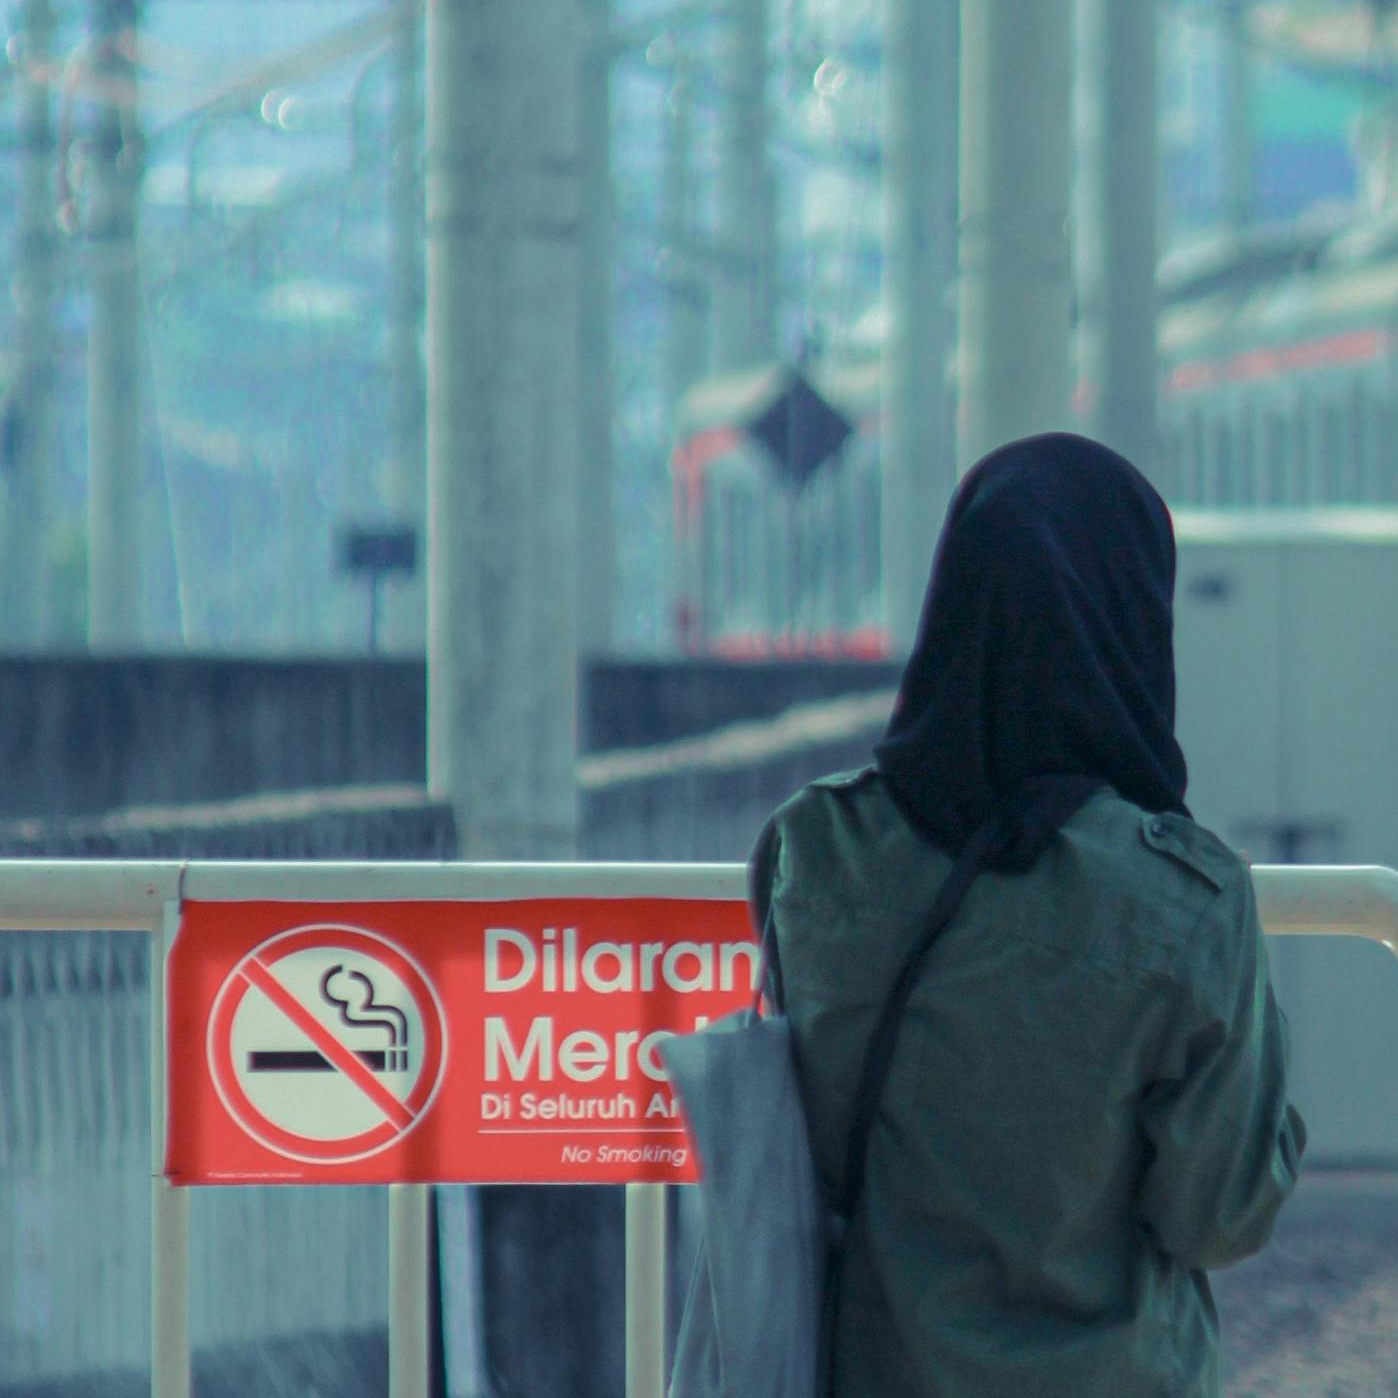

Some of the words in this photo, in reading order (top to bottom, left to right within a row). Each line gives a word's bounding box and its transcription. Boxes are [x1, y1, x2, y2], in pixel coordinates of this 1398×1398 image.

[484, 927, 763, 994] Dilaran
[481, 1093, 512, 1120] Di
[519, 1093, 636, 1120] Seluruh
[645, 1093, 681, 1119] Ar
[561, 1146, 592, 1164] No
[596, 1145, 688, 1167] Smoking
